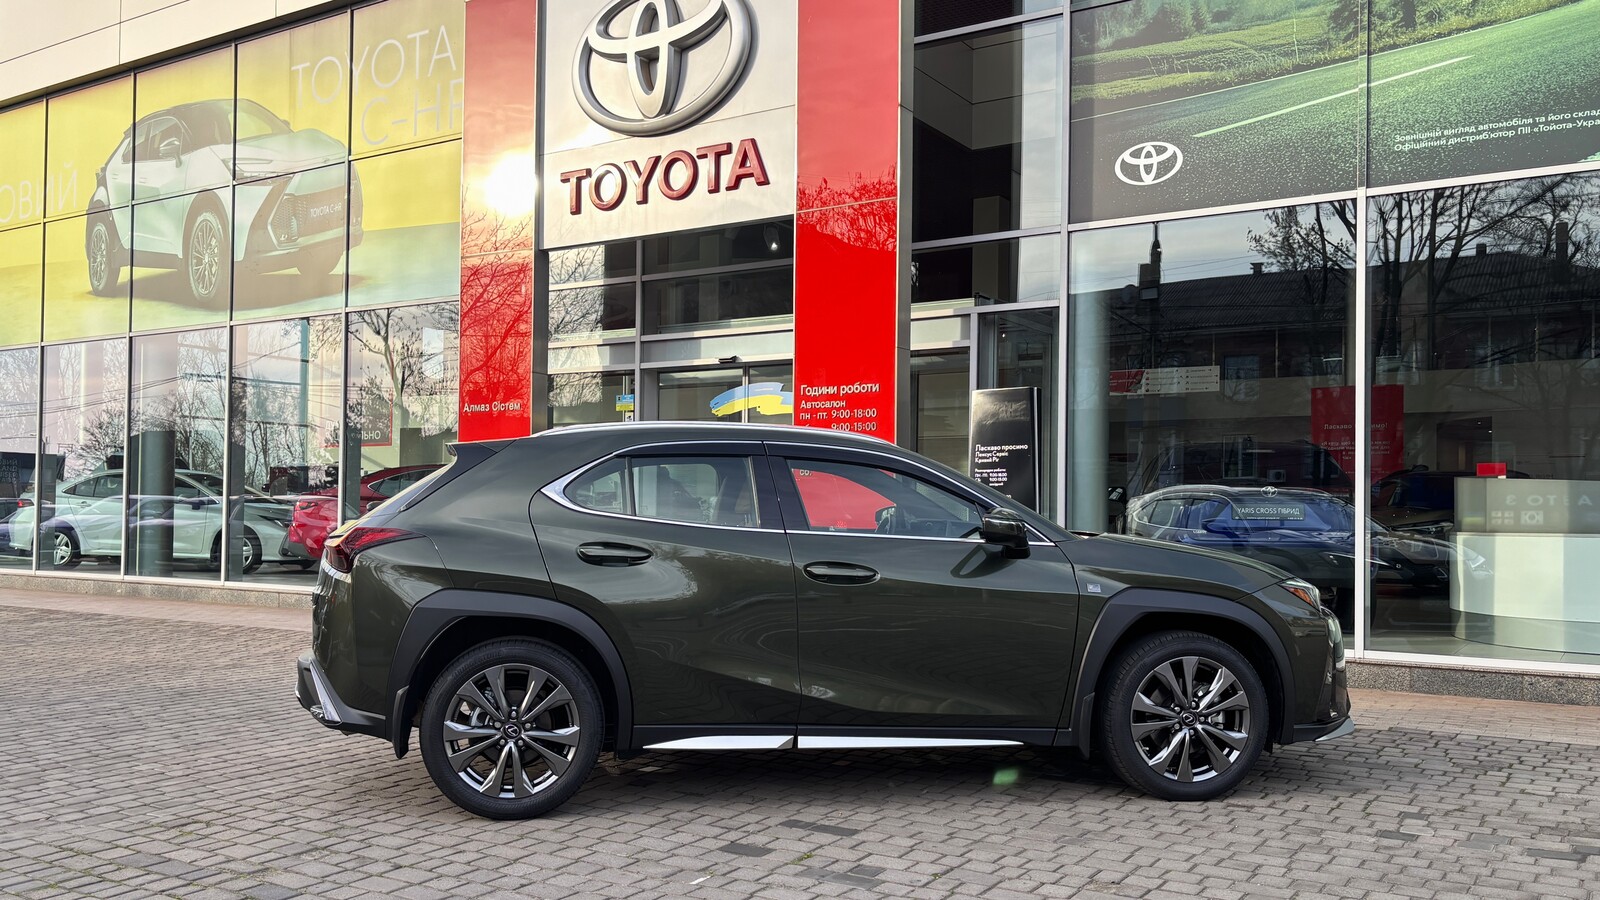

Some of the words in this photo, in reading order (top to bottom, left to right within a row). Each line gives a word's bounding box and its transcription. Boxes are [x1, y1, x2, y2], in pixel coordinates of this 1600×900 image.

[290, 24, 457, 110] TOYOTA
[1395, 127, 1442, 142] Зовнішній
[1444, 125, 1477, 136] вигляд
[1478, 117, 1533, 131] автомобіля
[1548, 112, 1571, 121] його
[1394, 137, 1446, 151] Офіційний
[1448, 130, 1516, 146] дистриб'ютор
[560, 138, 770, 215] TOYOTA
[800, 384, 837, 397] Години
[840, 382, 880, 396] роботи
[463, 402, 490, 412] Алмаз
[800, 400, 846, 409] Автосалон
[800, 412, 811, 420] пн
[831, 408, 877, 418] 9:00-18:00
[1278, 507, 1300, 515] ГІБРИД
